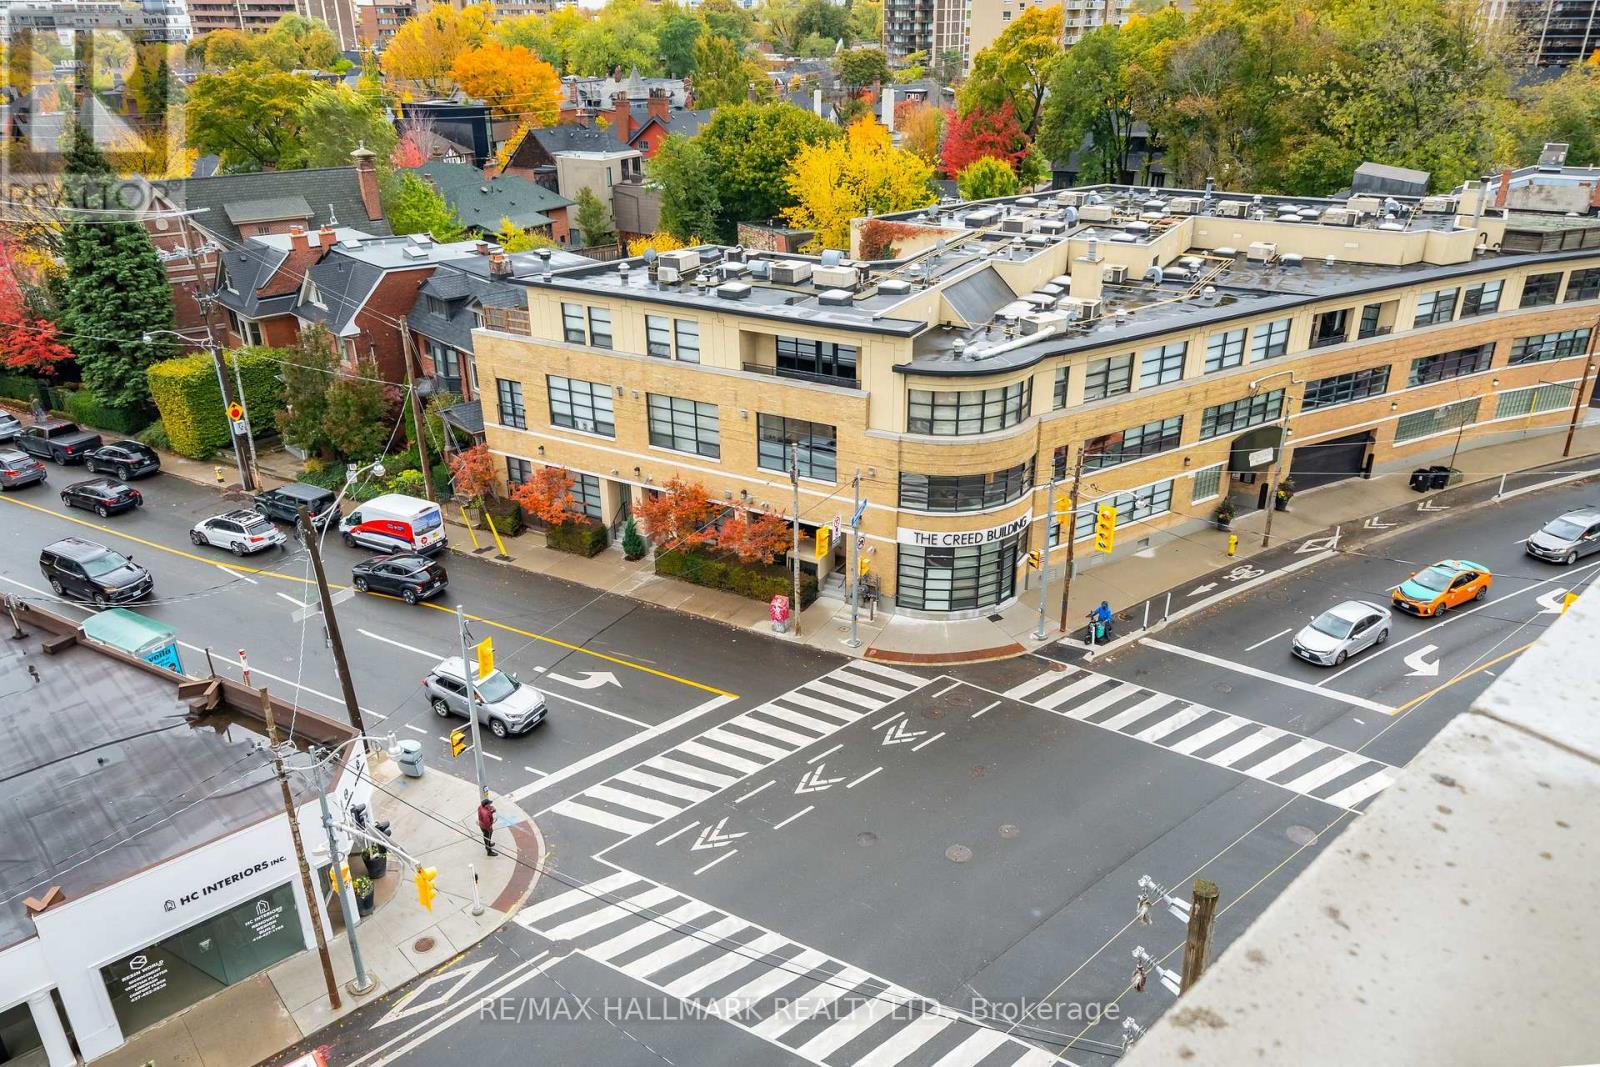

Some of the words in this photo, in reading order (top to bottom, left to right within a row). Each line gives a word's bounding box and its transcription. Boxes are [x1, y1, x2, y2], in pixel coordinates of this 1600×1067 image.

[914, 532, 938, 546] THE
[942, 532, 983, 546] CREED
[986, 516, 1027, 542] BUILDING
[180, 891, 199, 905] HC
[202, 860, 269, 896] INTERIORS
[270, 856, 287, 866] INC.
